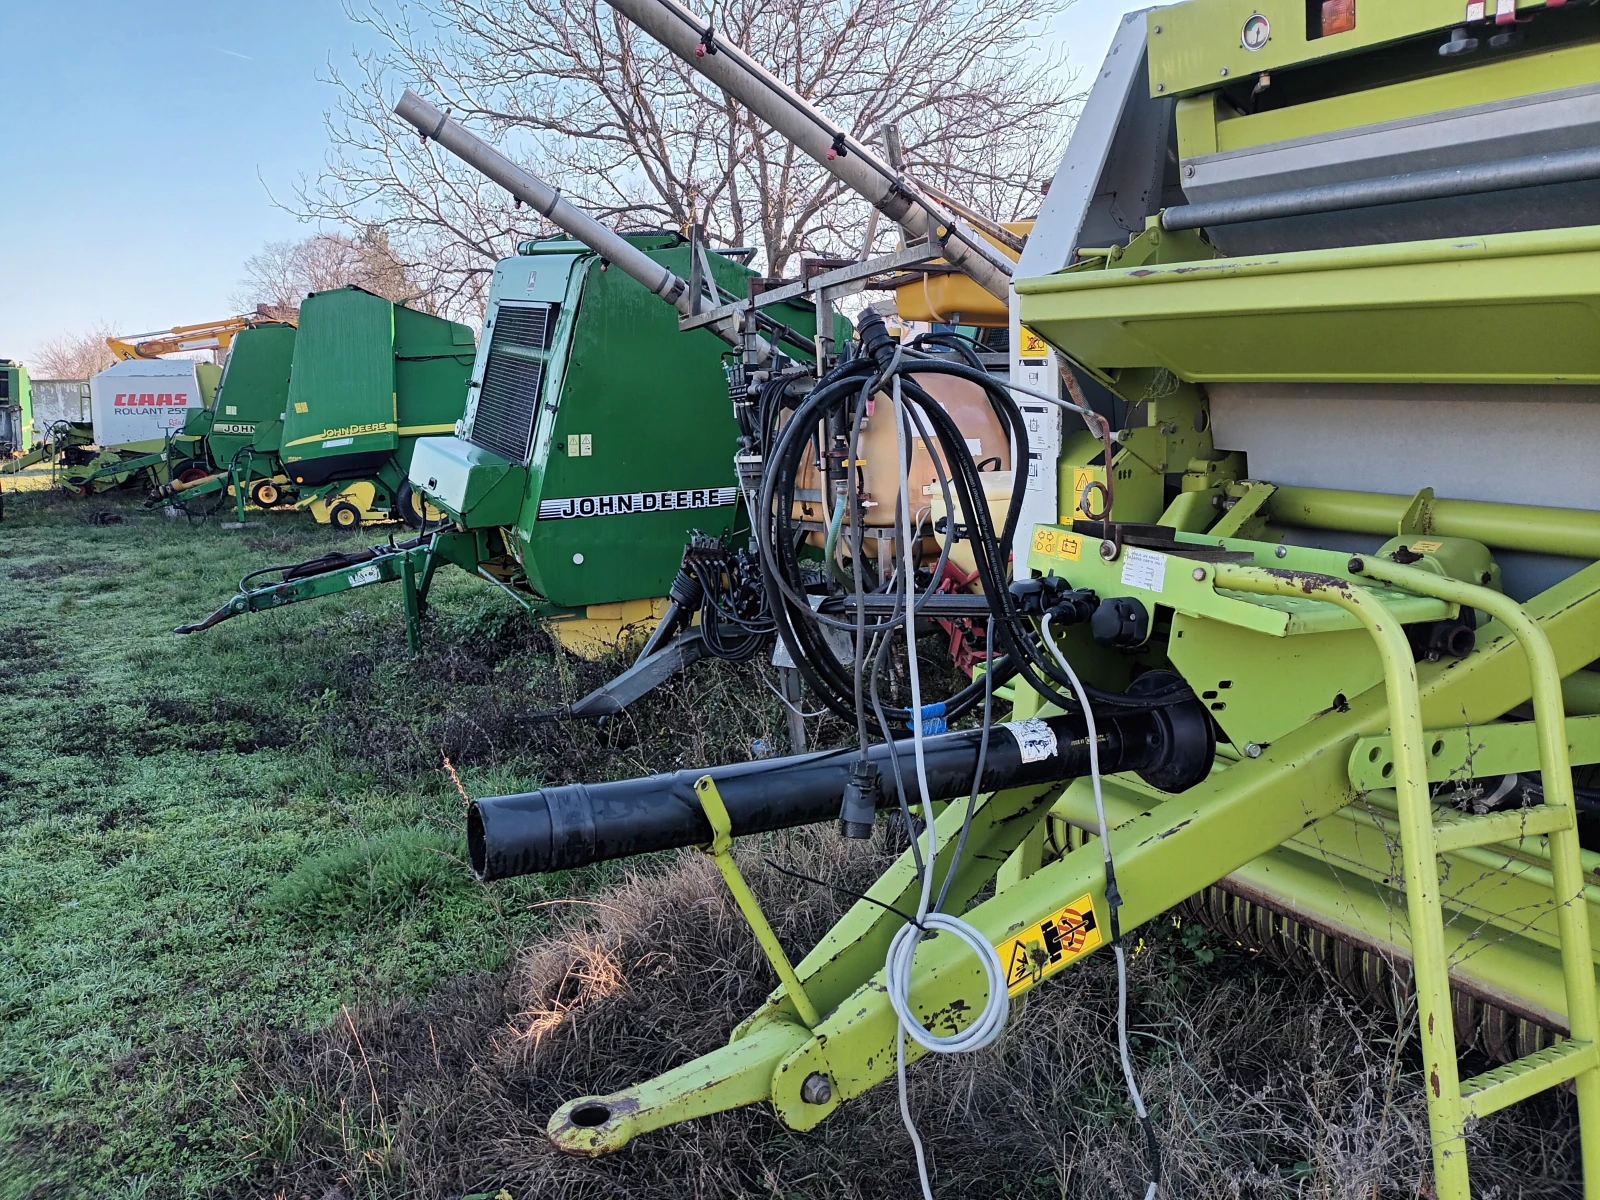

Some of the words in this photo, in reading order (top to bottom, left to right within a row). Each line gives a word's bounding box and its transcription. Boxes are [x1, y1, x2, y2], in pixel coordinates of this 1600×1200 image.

[114, 393, 187, 406] CLAAS
[114, 407, 163, 415] ROLLANT
[323, 427, 351, 438] JOHN
[350, 422, 386, 434] DEERE
[562, 495, 634, 517] JOHN
[643, 489, 720, 511] DEERE
